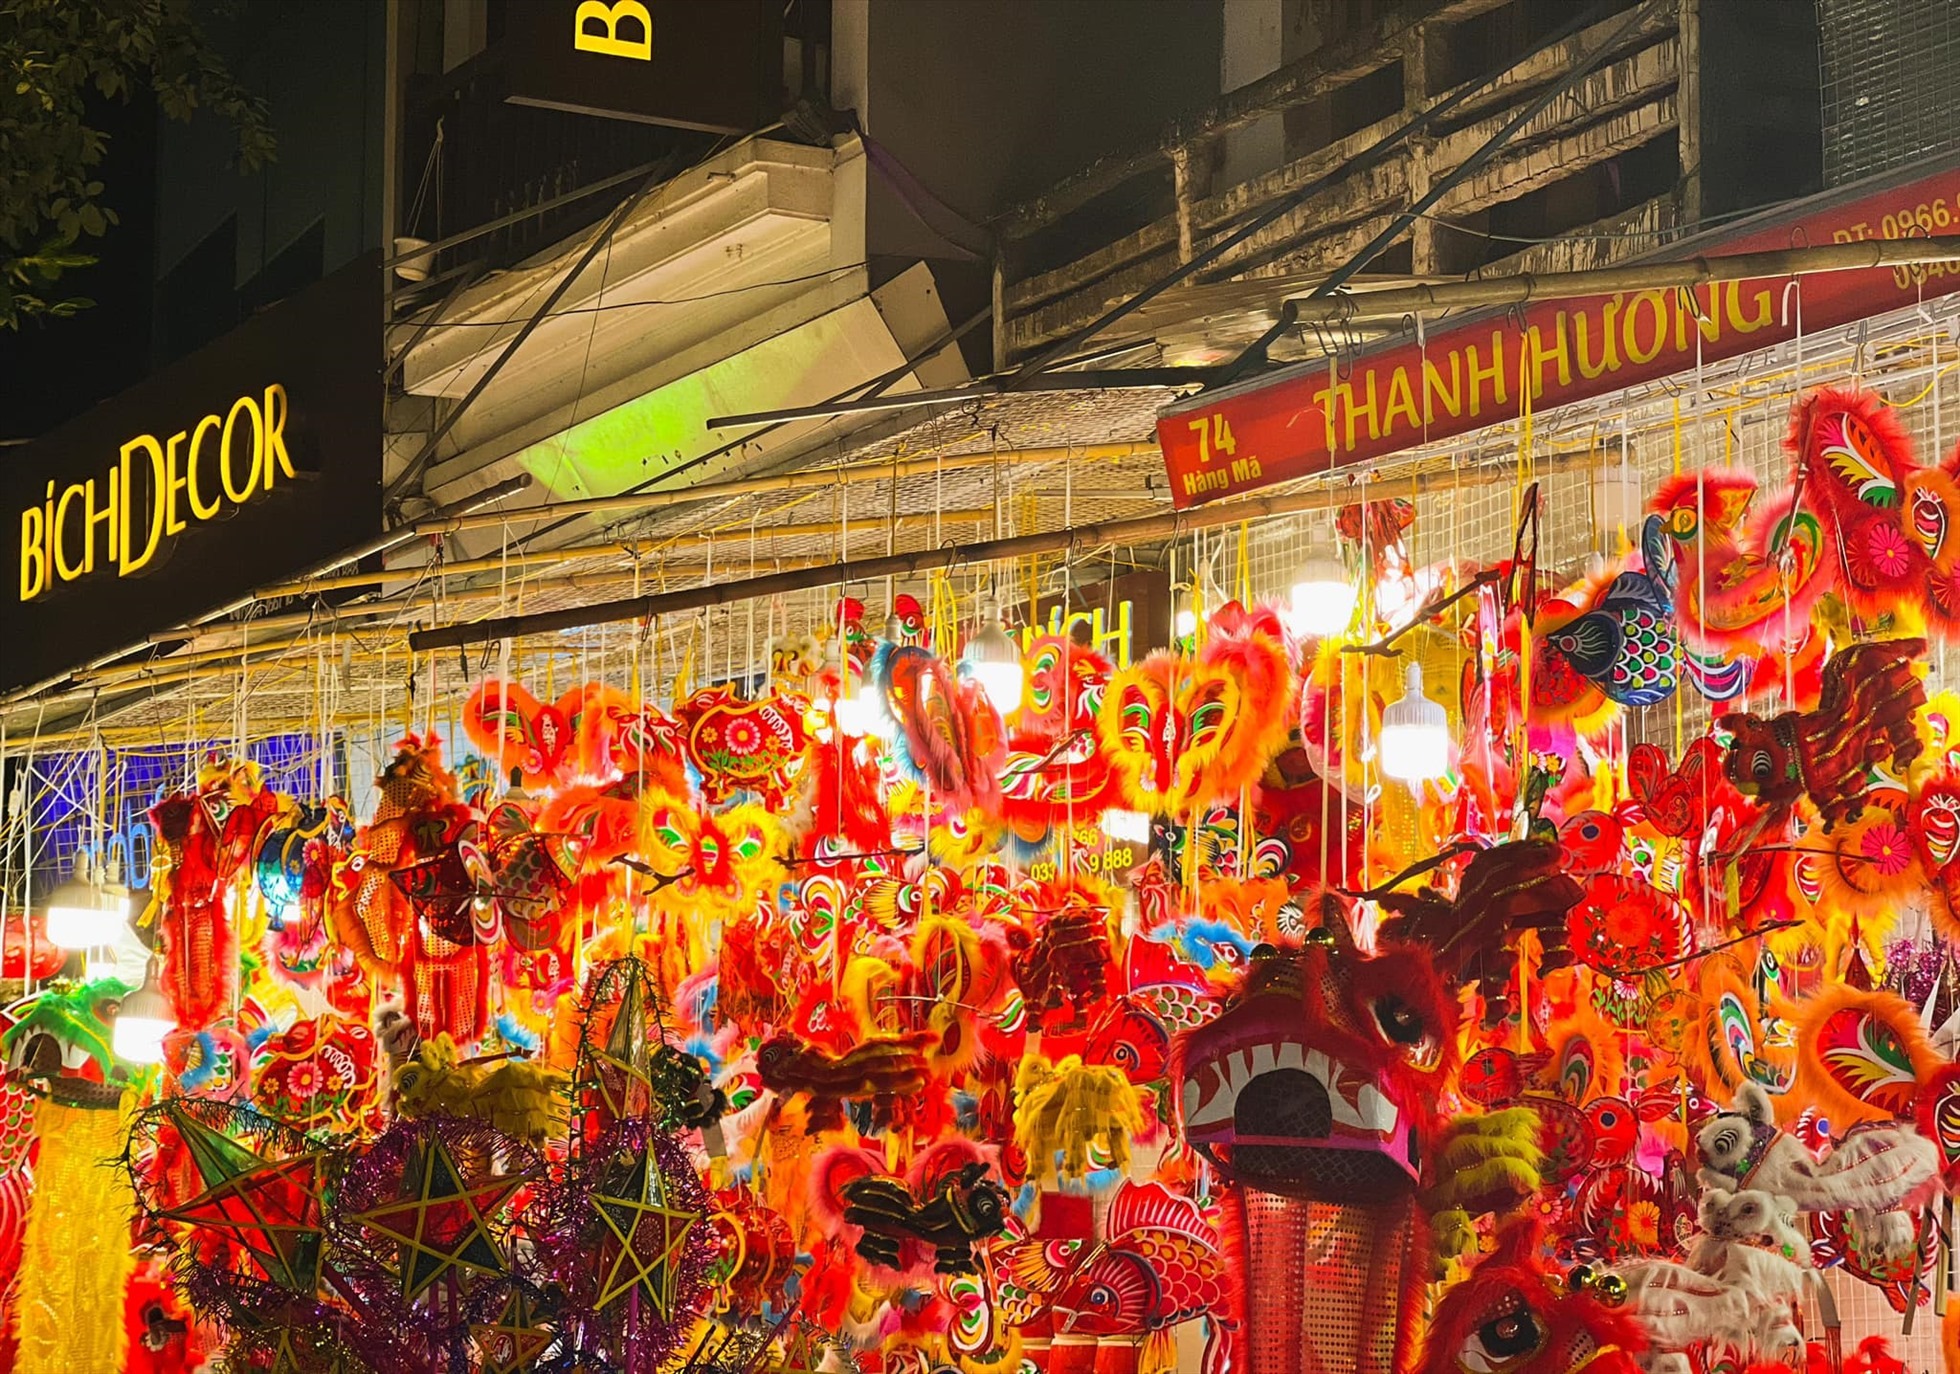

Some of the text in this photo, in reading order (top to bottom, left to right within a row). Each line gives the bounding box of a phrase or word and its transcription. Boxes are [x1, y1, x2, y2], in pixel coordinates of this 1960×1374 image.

[1881, 192, 1960, 240] 0966.
[1313, 330, 1507, 453] THANH
[1188, 413, 1237, 463] 74
[1182, 455, 1263, 496] Hàng Mã
